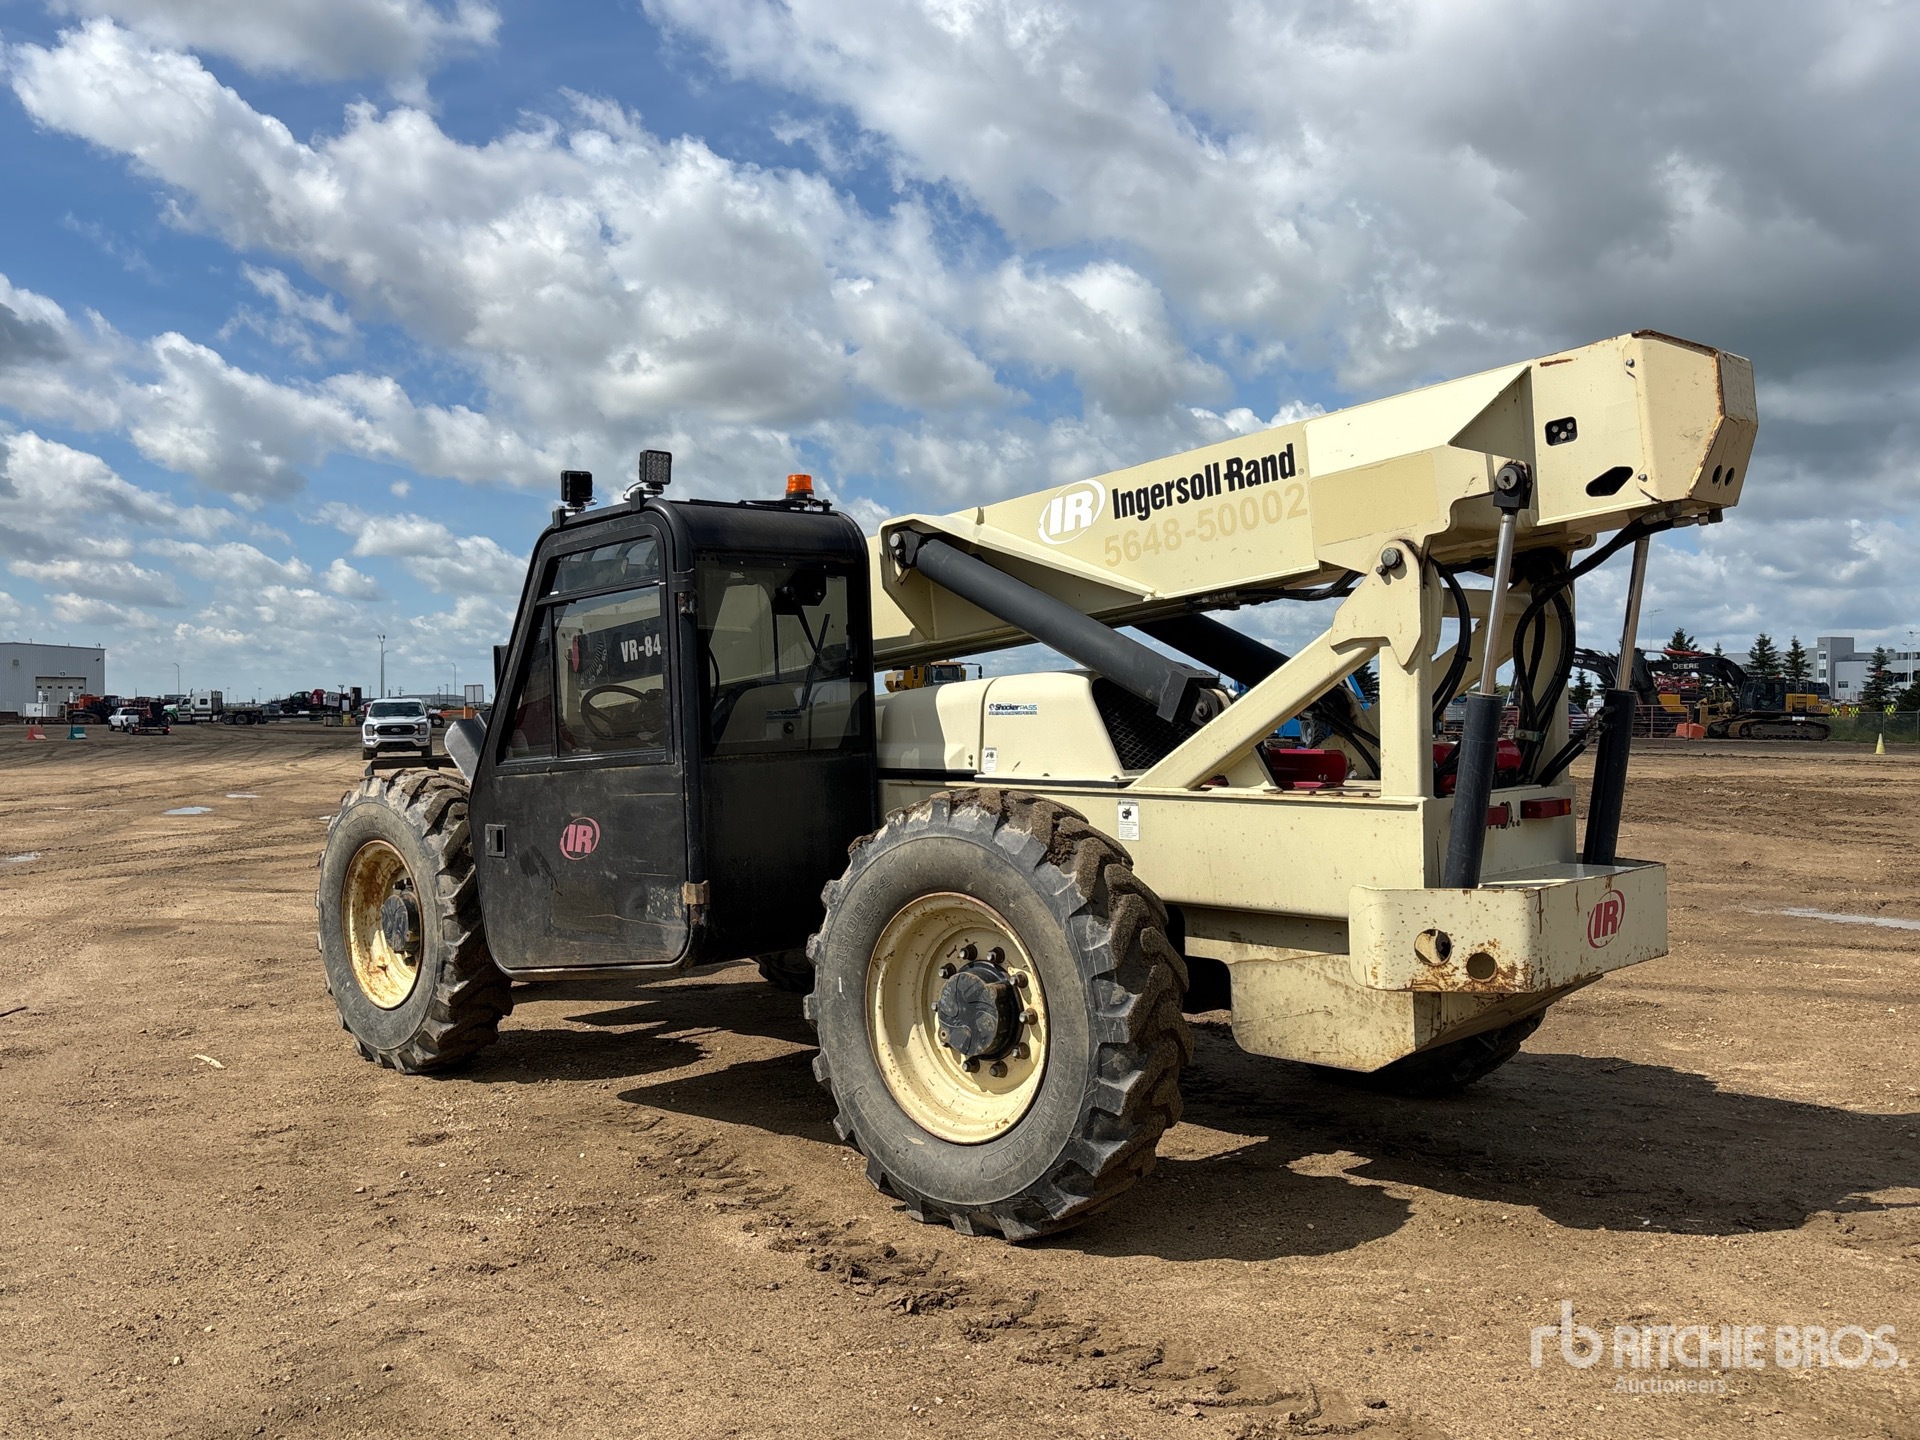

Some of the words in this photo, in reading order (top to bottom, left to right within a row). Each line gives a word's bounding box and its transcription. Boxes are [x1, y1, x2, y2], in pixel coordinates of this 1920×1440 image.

[1111, 461, 1222, 522] Ingersoll
[1049, 489, 1095, 537] IR
[1104, 482, 1308, 568] 5648-50002
[620, 633, 662, 663] VR-84
[1672, 662, 1700, 670] DEERE
[566, 823, 594, 854] IR
[1593, 899, 1619, 940] IR
